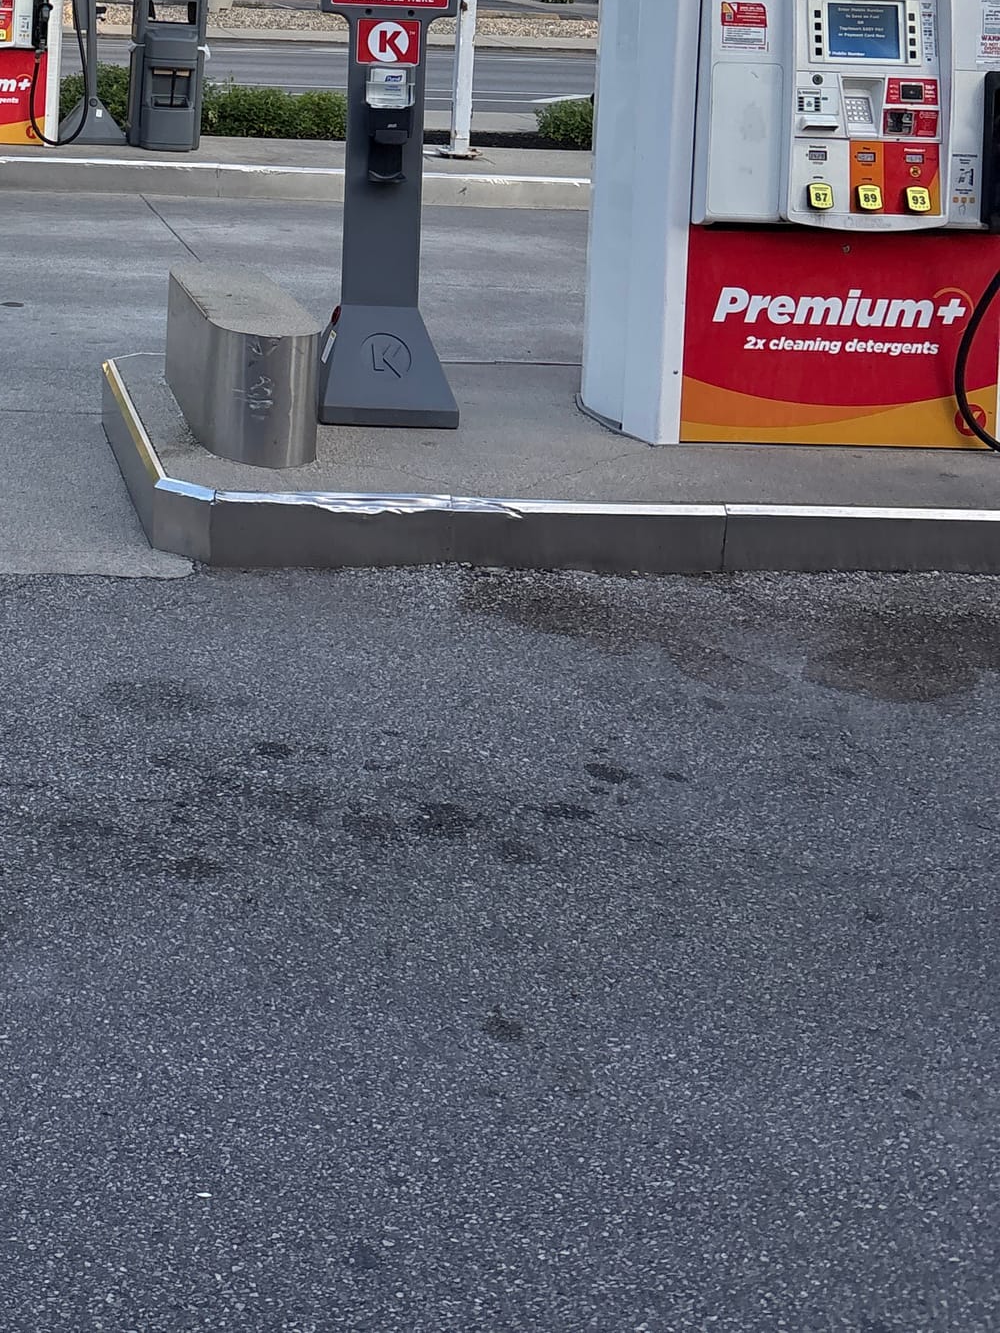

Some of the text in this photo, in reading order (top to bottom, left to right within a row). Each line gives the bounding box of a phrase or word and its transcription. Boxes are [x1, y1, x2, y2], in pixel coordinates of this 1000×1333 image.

[379, 30, 406, 61] K
[814, 192, 828, 202] 87
[863, 193, 877, 203] 89
[911, 195, 926, 205] 93
[712, 286, 967, 328] Premium+
[744, 335, 940, 357] 2x cleaning detergents
